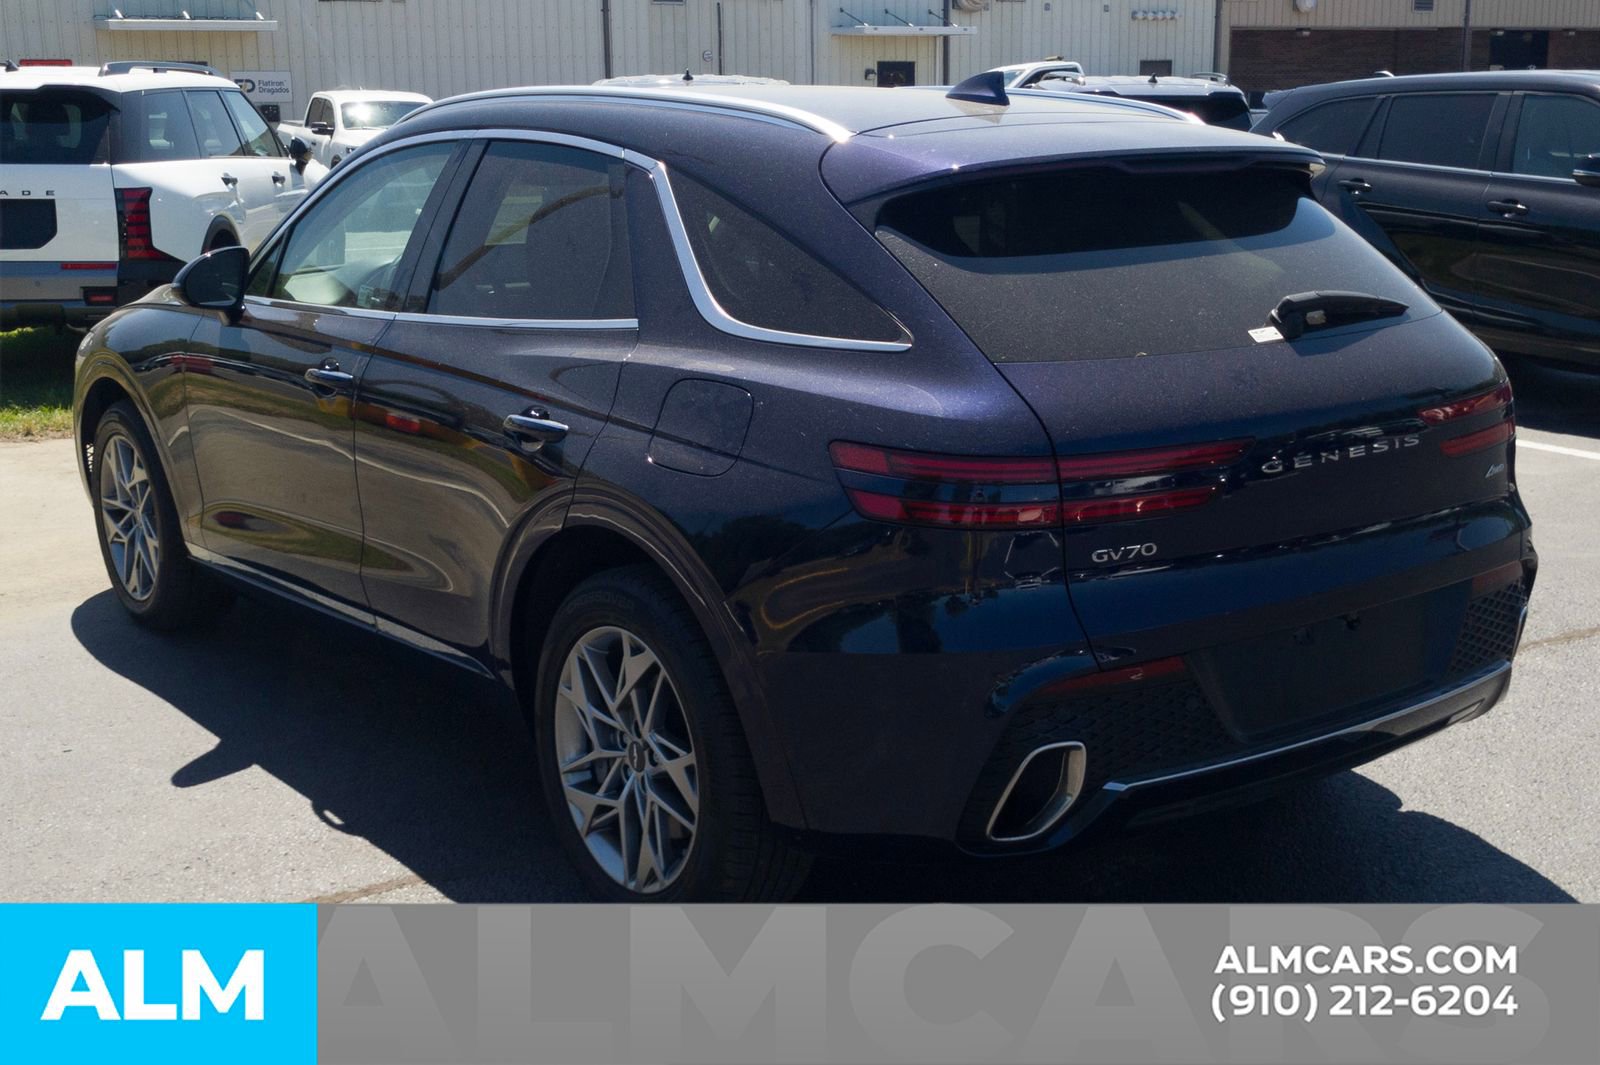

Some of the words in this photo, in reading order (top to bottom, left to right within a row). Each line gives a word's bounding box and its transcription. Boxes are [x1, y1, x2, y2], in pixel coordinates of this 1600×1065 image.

[258, 79, 286, 87] Flatiron
[258, 87, 290, 95] Dragados
[1261, 434, 1421, 474] GENESIS
[1091, 542, 1158, 563] GV70
